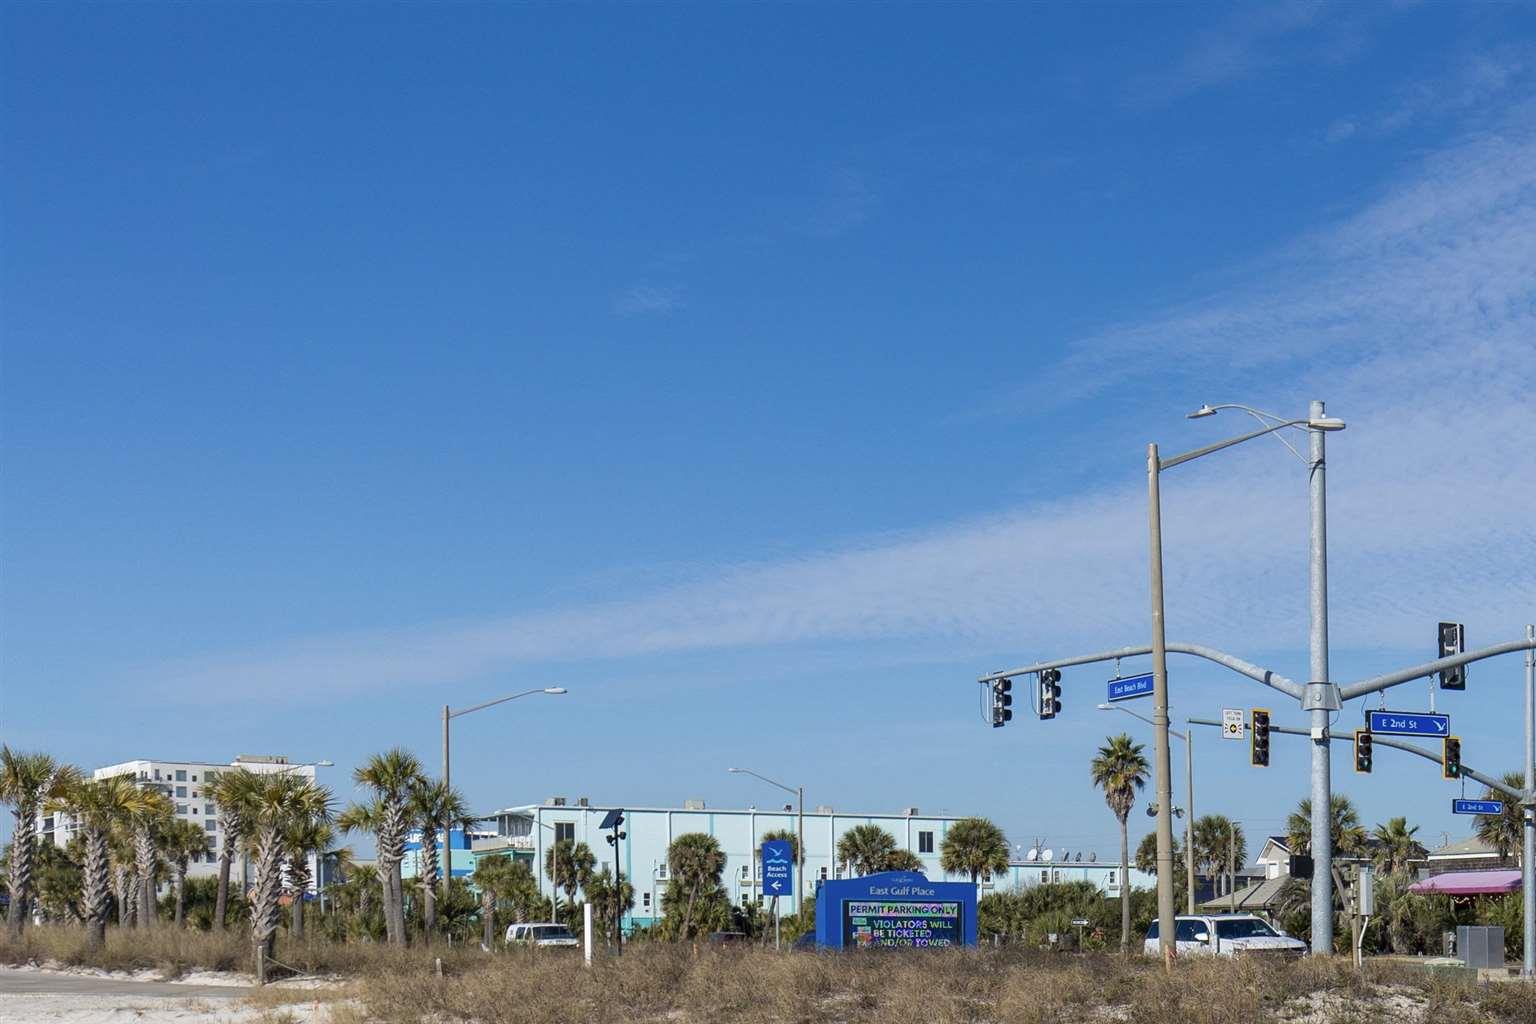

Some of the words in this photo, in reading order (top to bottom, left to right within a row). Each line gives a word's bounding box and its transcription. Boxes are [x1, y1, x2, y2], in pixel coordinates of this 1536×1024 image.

[1124, 683, 1137, 692] Beach
[1137, 680, 1147, 689] Blvd
[1382, 718, 1387, 727] E
[1390, 718, 1406, 729] 2nd
[1408, 719, 1417, 729] St
[869, 886, 889, 896] East
[890, 886, 910, 896] Gulf
[911, 887, 936, 897] Place
[850, 904, 886, 914] PERMIT
[886, 904, 929, 914] PARKING
[930, 904, 957, 914] ONLY
[873, 920, 927, 929] VIOLATORS
[929, 920, 953, 929] WILL
[873, 929, 885, 938] BE
[887, 929, 932, 938] TICKETED
[873, 938, 912, 948] AND/OR
[914, 938, 951, 948] TOWED
